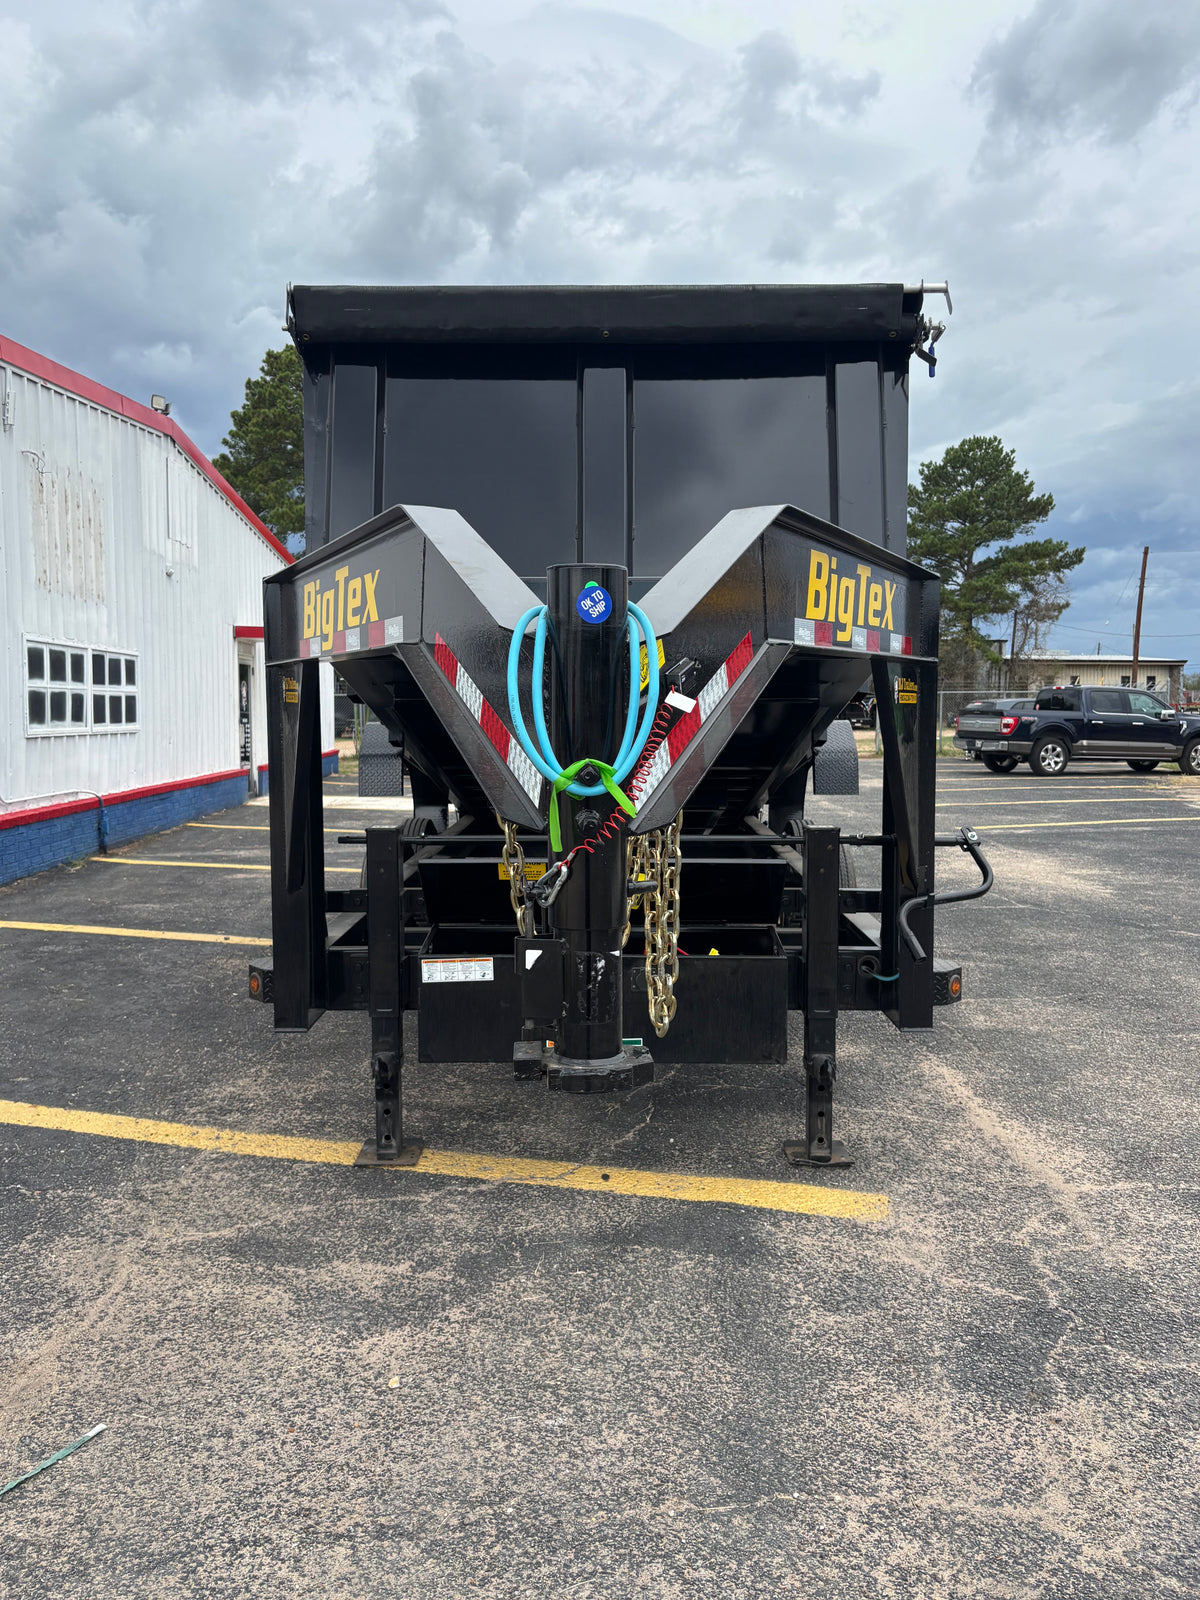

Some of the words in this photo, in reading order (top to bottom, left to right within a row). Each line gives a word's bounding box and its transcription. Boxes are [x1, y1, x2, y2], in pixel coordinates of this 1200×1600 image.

[303, 565, 380, 651] BigTex
[580, 597, 594, 610] OK
[591, 590, 604, 602] TO
[588, 600, 606, 618] SHIP
[805, 549, 897, 642] BigTex
